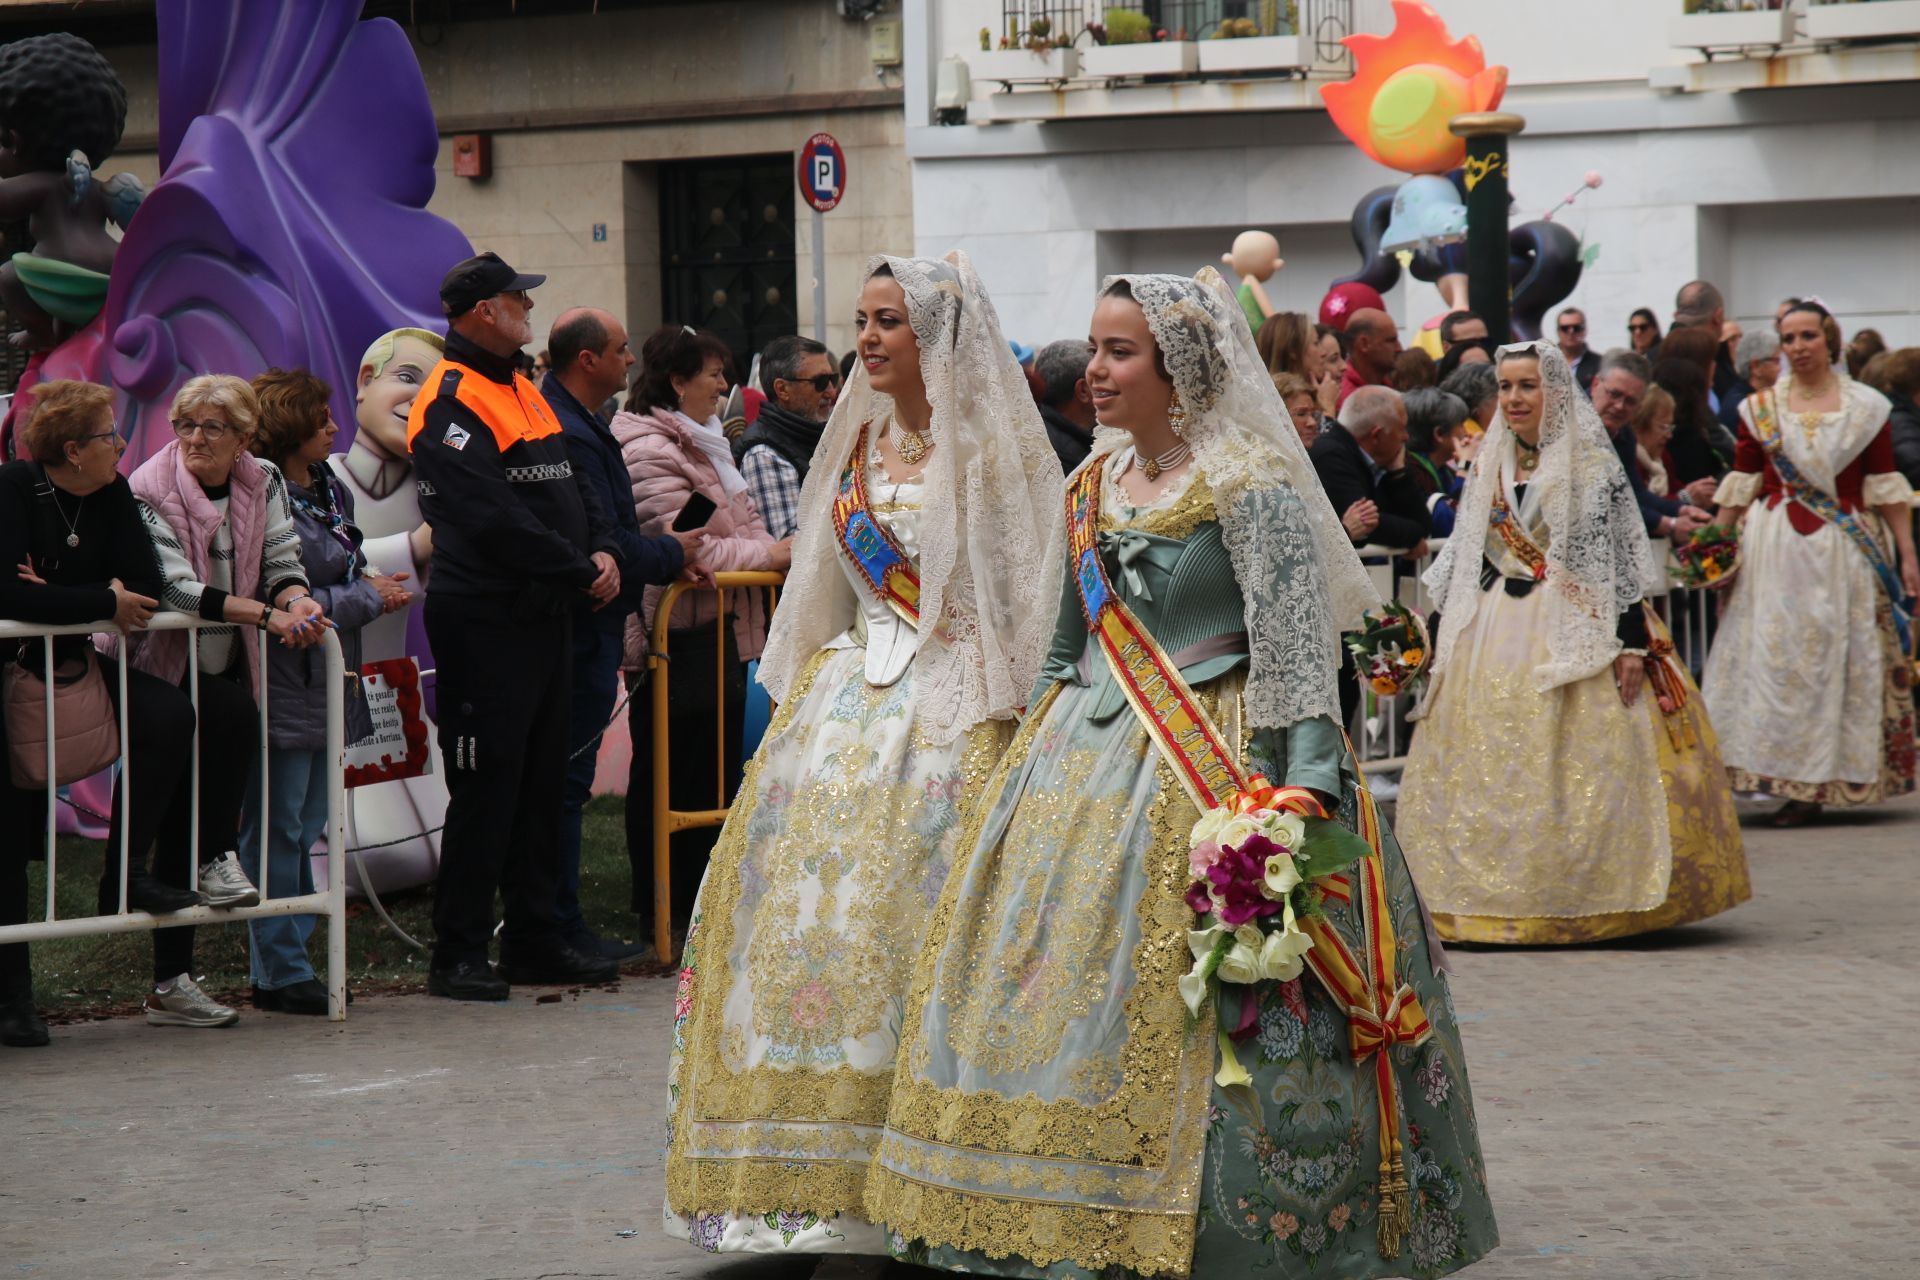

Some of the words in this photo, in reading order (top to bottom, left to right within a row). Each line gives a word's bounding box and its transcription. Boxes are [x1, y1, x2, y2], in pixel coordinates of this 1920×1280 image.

[812, 134, 835, 147] MOTOS
[819, 161, 830, 185] P
[814, 198, 836, 209] MOTOS
